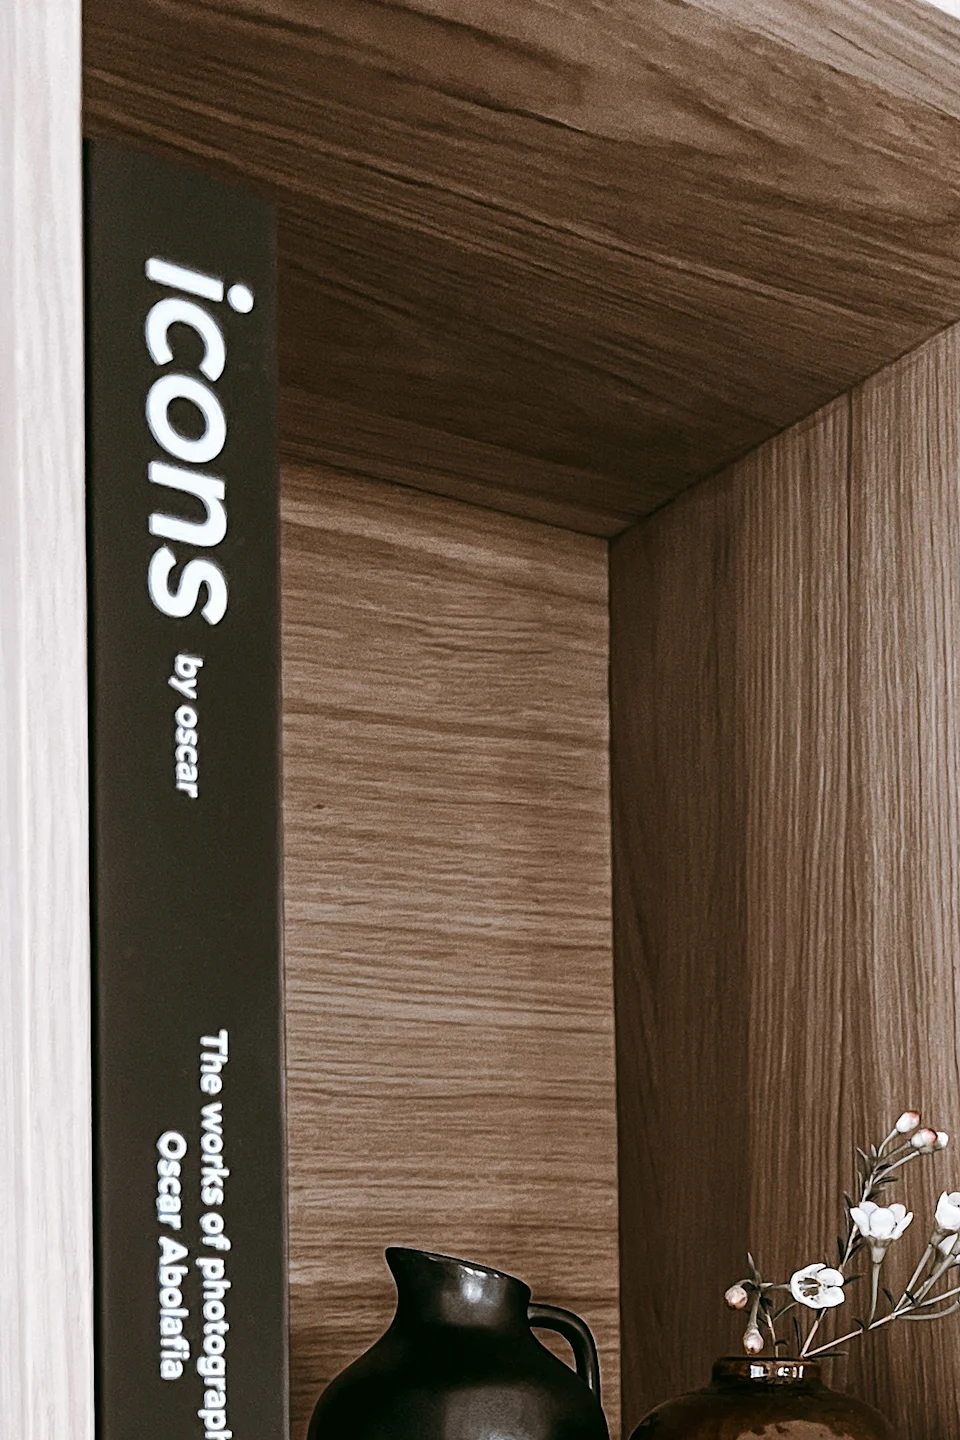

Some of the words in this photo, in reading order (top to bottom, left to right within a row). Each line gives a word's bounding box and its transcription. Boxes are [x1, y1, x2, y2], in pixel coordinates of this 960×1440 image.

[145, 257, 254, 627] icons
[168, 653, 204, 700] by
[174, 704, 200, 799] oscar
[199, 1028, 229, 1096] The
[156, 1130, 188, 1231] Oscar
[200, 1101, 230, 1207] works
[200, 1211, 232, 1252] of
[157, 1235, 191, 1381] Abolafia
